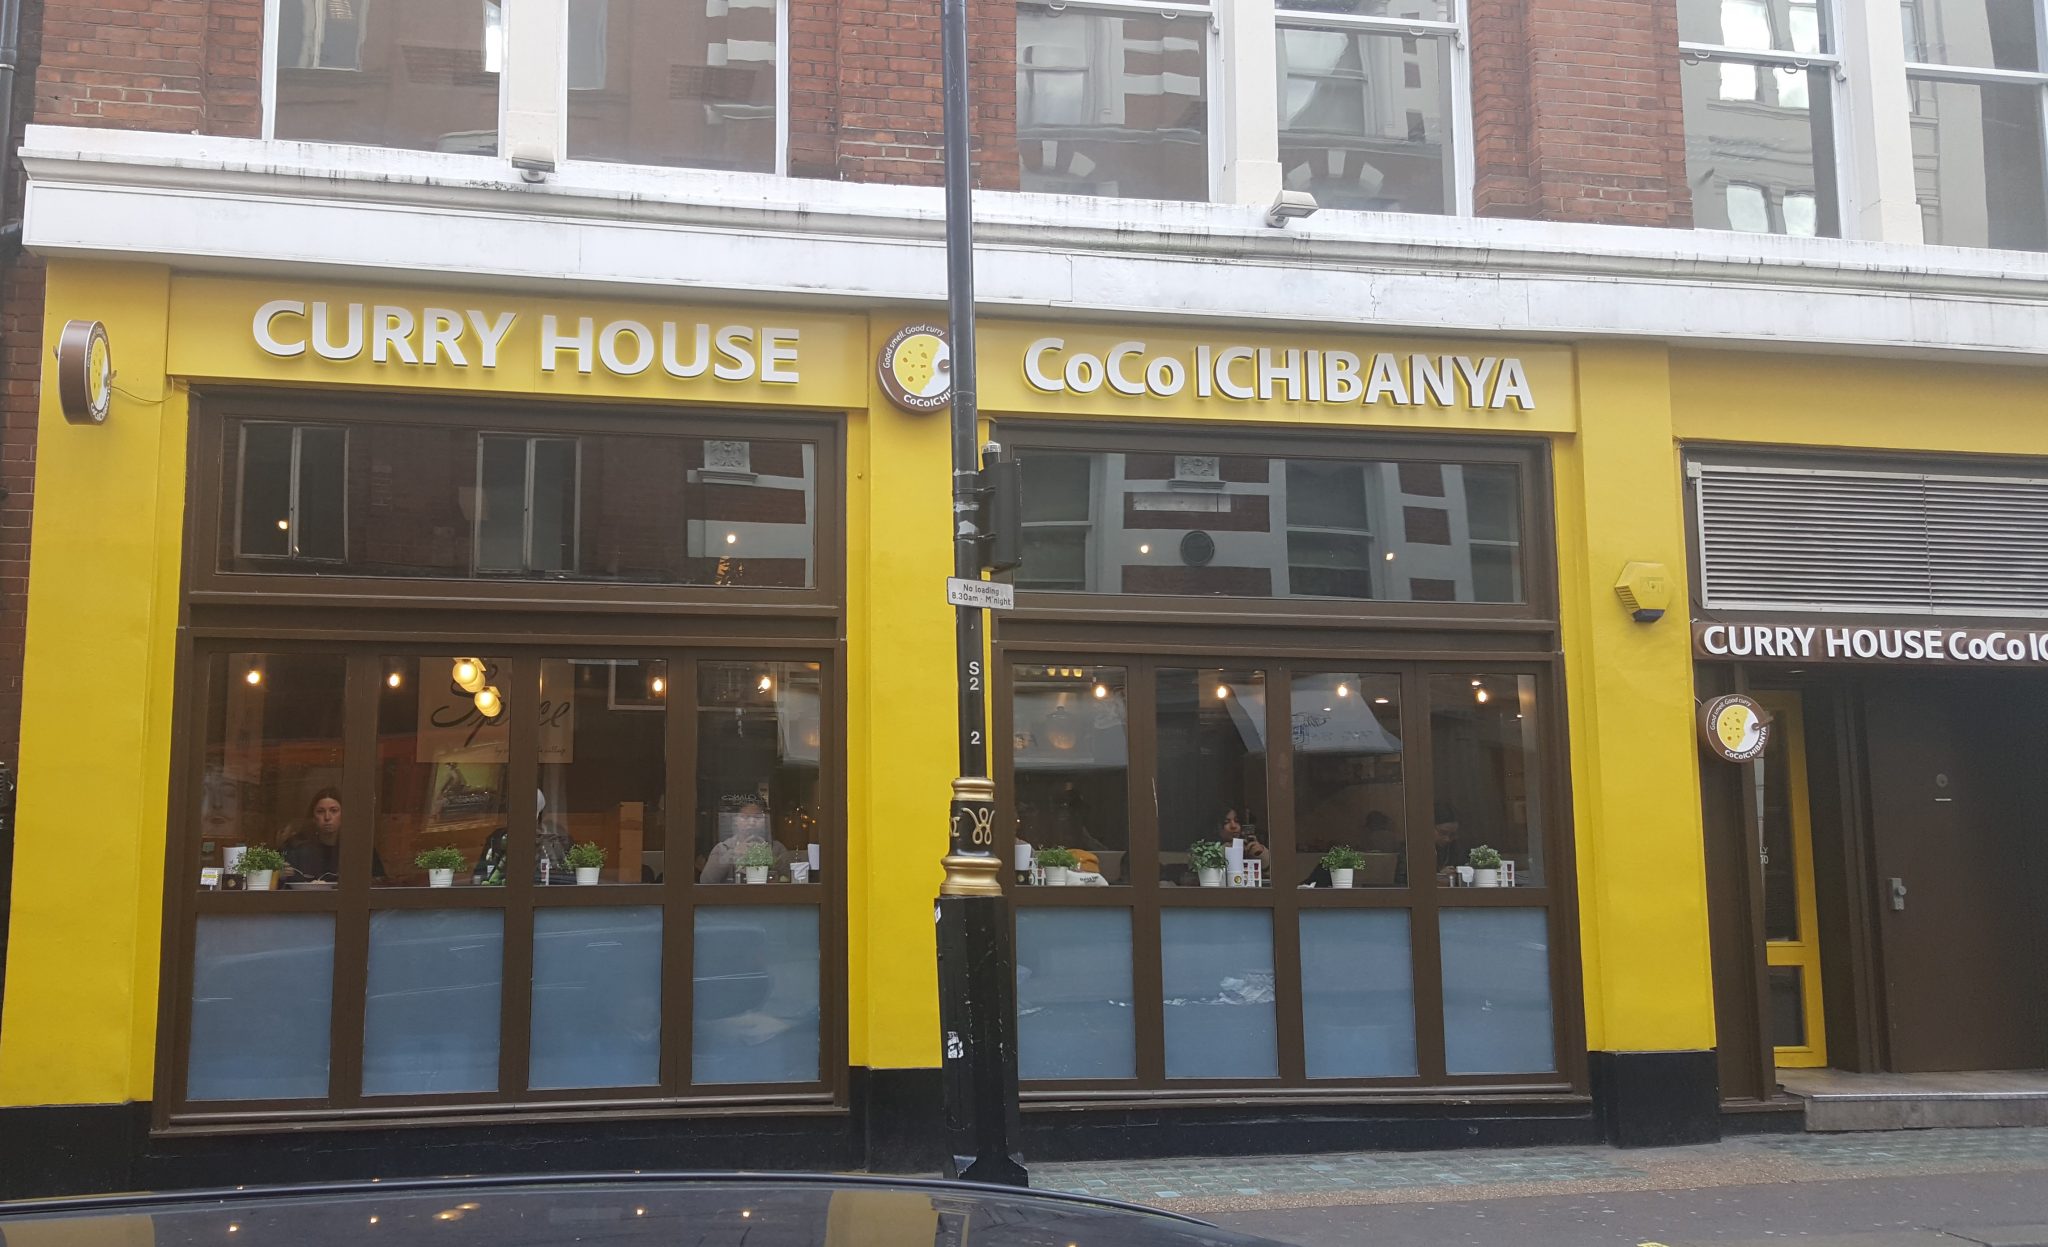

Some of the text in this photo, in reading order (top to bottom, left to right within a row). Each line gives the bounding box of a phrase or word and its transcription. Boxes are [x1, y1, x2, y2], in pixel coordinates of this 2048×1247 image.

[252, 299, 800, 385] CURRY HOUSE
[882, 347, 893, 369] Good
[905, 324, 926, 335] Good
[926, 324, 945, 337] curry
[963, 583, 1000, 596] No loading
[951, 591, 979, 602] 8.30am
[985, 595, 1011, 606] M'night
[1703, 625, 1816, 657] CURRY
[1825, 627, 1945, 660] HOUSE
[968, 660, 980, 675] S
[969, 677, 980, 691] 2
[1709, 713, 1717, 731] Good
[1724, 696, 1739, 705] Good
[1738, 697, 1752, 707] curry
[970, 730, 981, 745] 2
